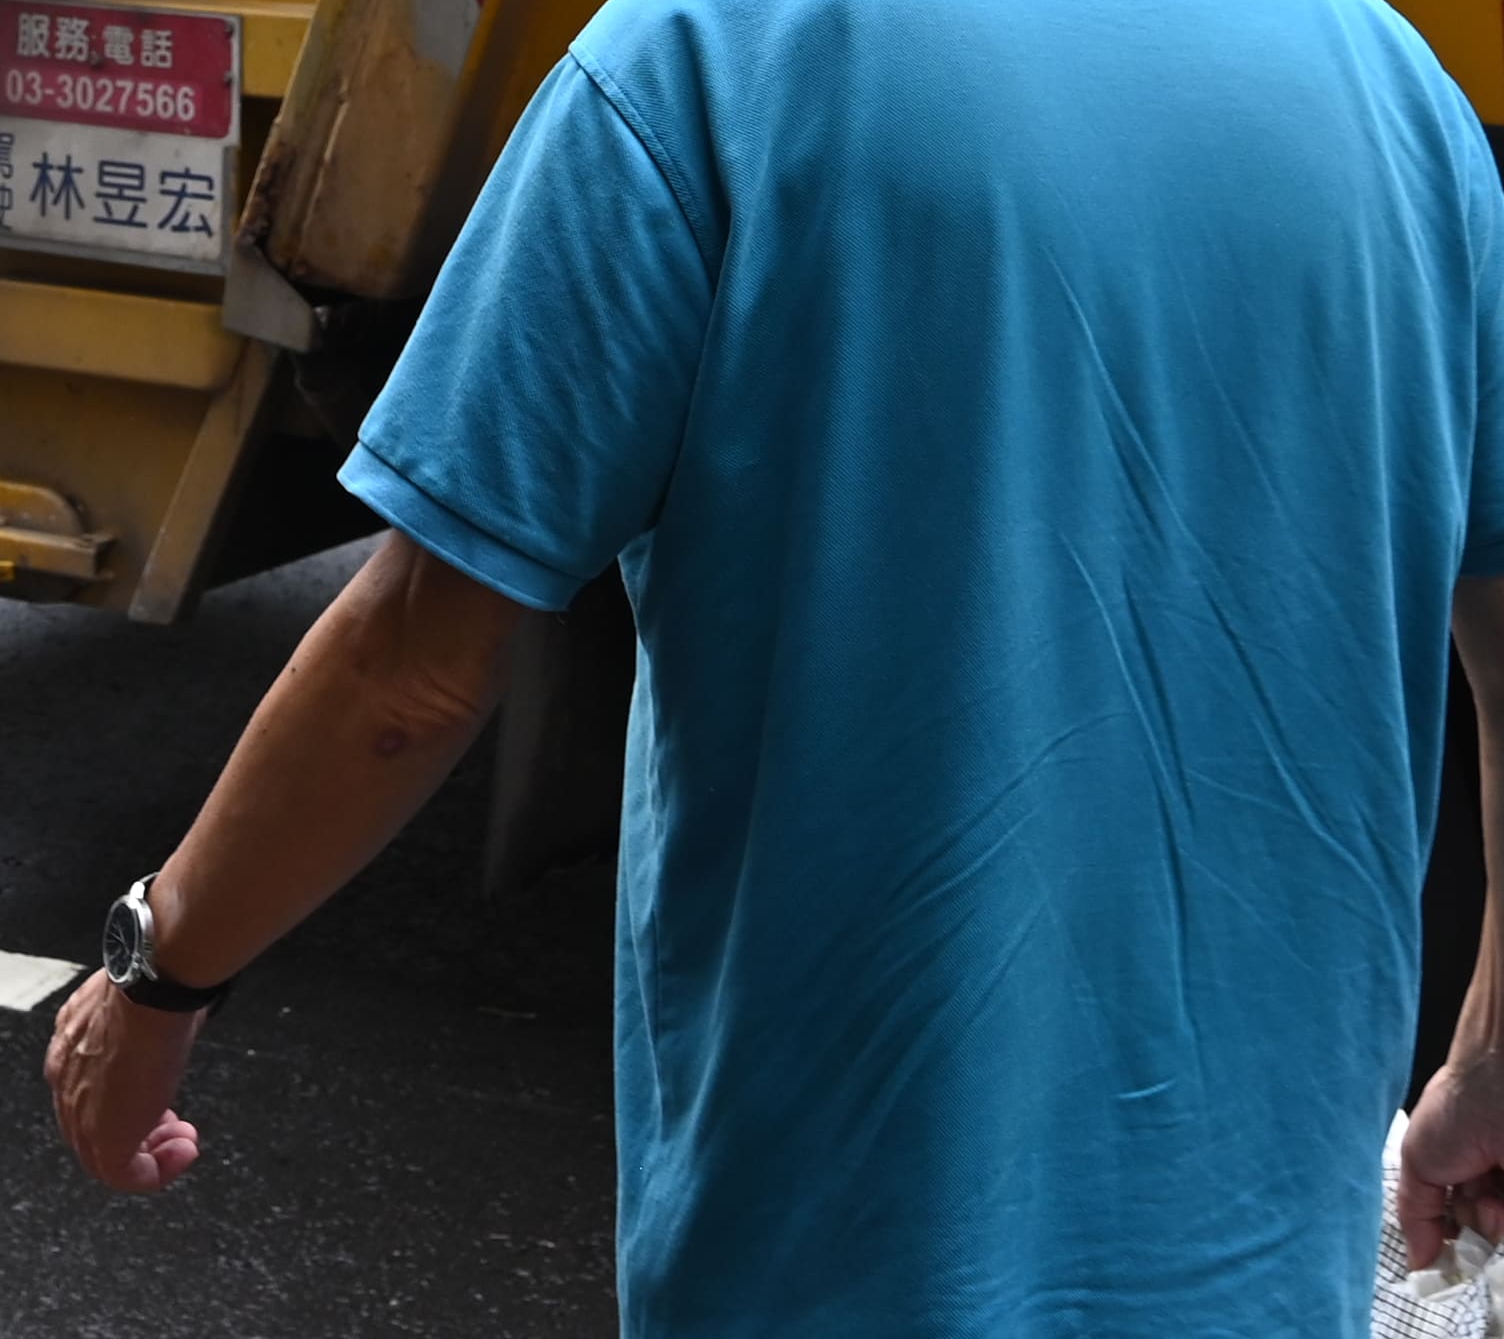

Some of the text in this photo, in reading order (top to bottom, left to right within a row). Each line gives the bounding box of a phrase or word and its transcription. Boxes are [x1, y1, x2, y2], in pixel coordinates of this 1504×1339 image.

[16, 11, 174, 69] 服務電話
[5, 68, 197, 123] 03-3027566
[29, 150, 217, 238] 林昱宏
